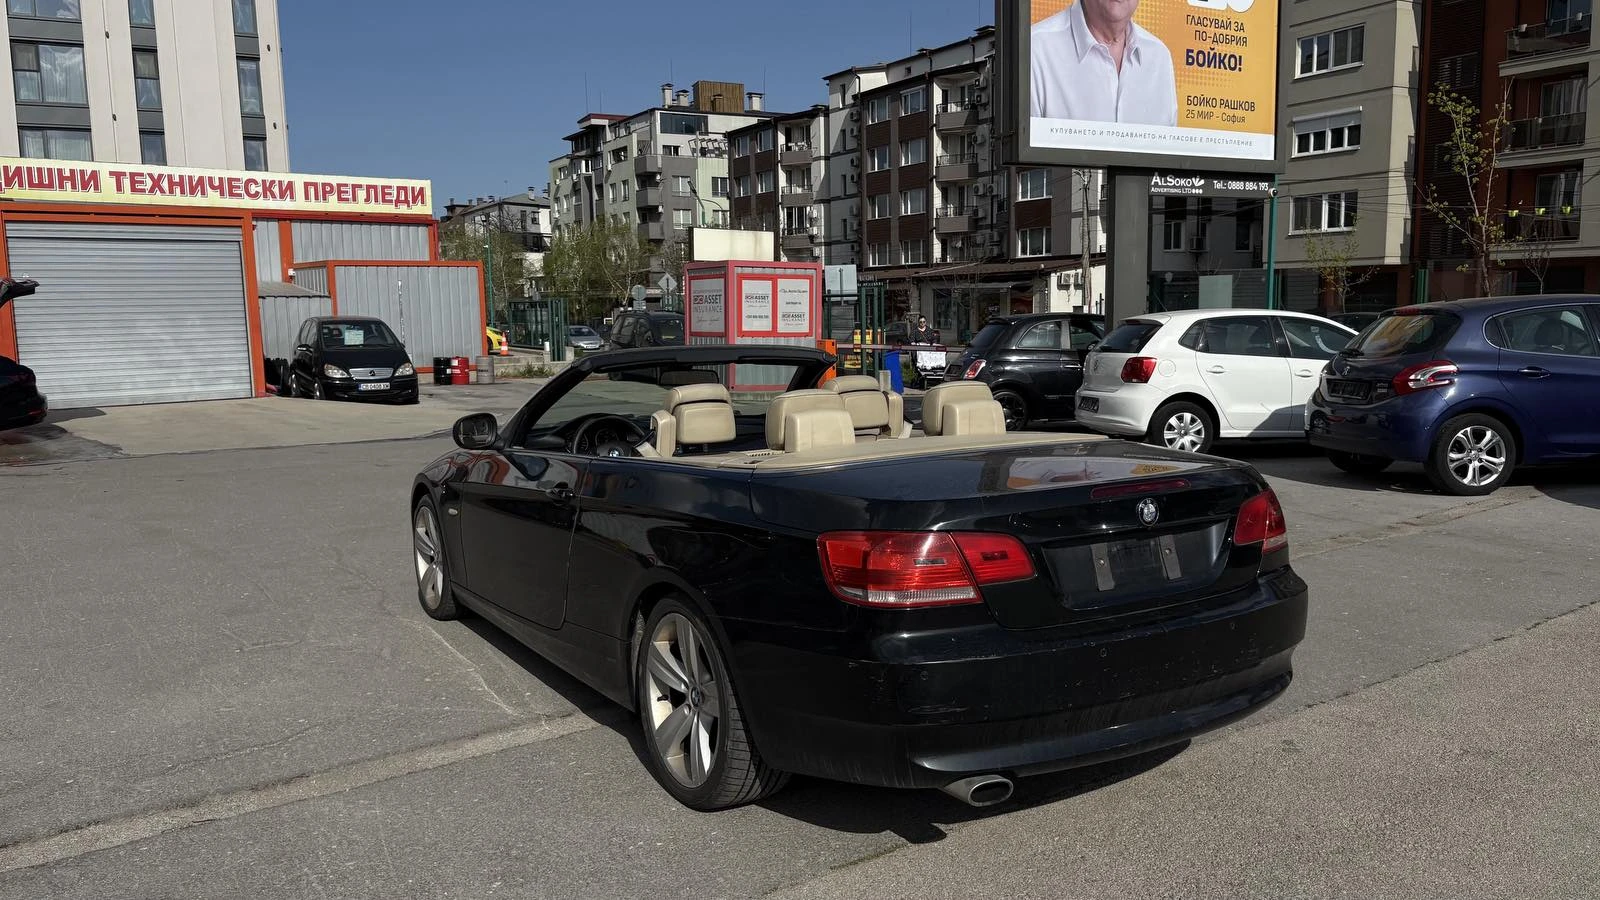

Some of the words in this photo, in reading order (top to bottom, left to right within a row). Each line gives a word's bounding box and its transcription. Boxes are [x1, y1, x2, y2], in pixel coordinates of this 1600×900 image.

[1186, 14, 1232, 31] ГЛАСУВАЙ
[1233, 21, 1245, 33] ЗА
[1194, 29, 1248, 47] ПО-ДОБРИЯ
[1185, 46, 1243, 72] БОЙКО!
[1186, 94, 1218, 109] БОЙКО
[1219, 98, 1256, 112] РАШКОВ
[1185, 109, 1196, 119] 25
[1196, 110, 1214, 120] МИР
[1221, 112, 1246, 124] София
[1050, 127, 1097, 136] КУПУВАНЕТО
[1106, 130, 1156, 140] ПРОДАВАНЕТО
[1169, 134, 1197, 143] ГЛАСОВЕ
[1205, 137, 1253, 147] ПРЕСТЪПЛЕНИЕ
[0, 164, 101, 193] ИШНИ
[109, 170, 296, 202] ТЕХНИЧЕСКИ
[303, 181, 427, 209] ПРЕГЛЕДИ
[1227, 181, 1244, 191] 0888
[1245, 182, 1258, 191] 884
[1259, 182, 1269, 191] 193
[704, 294, 723, 305] ASSET
